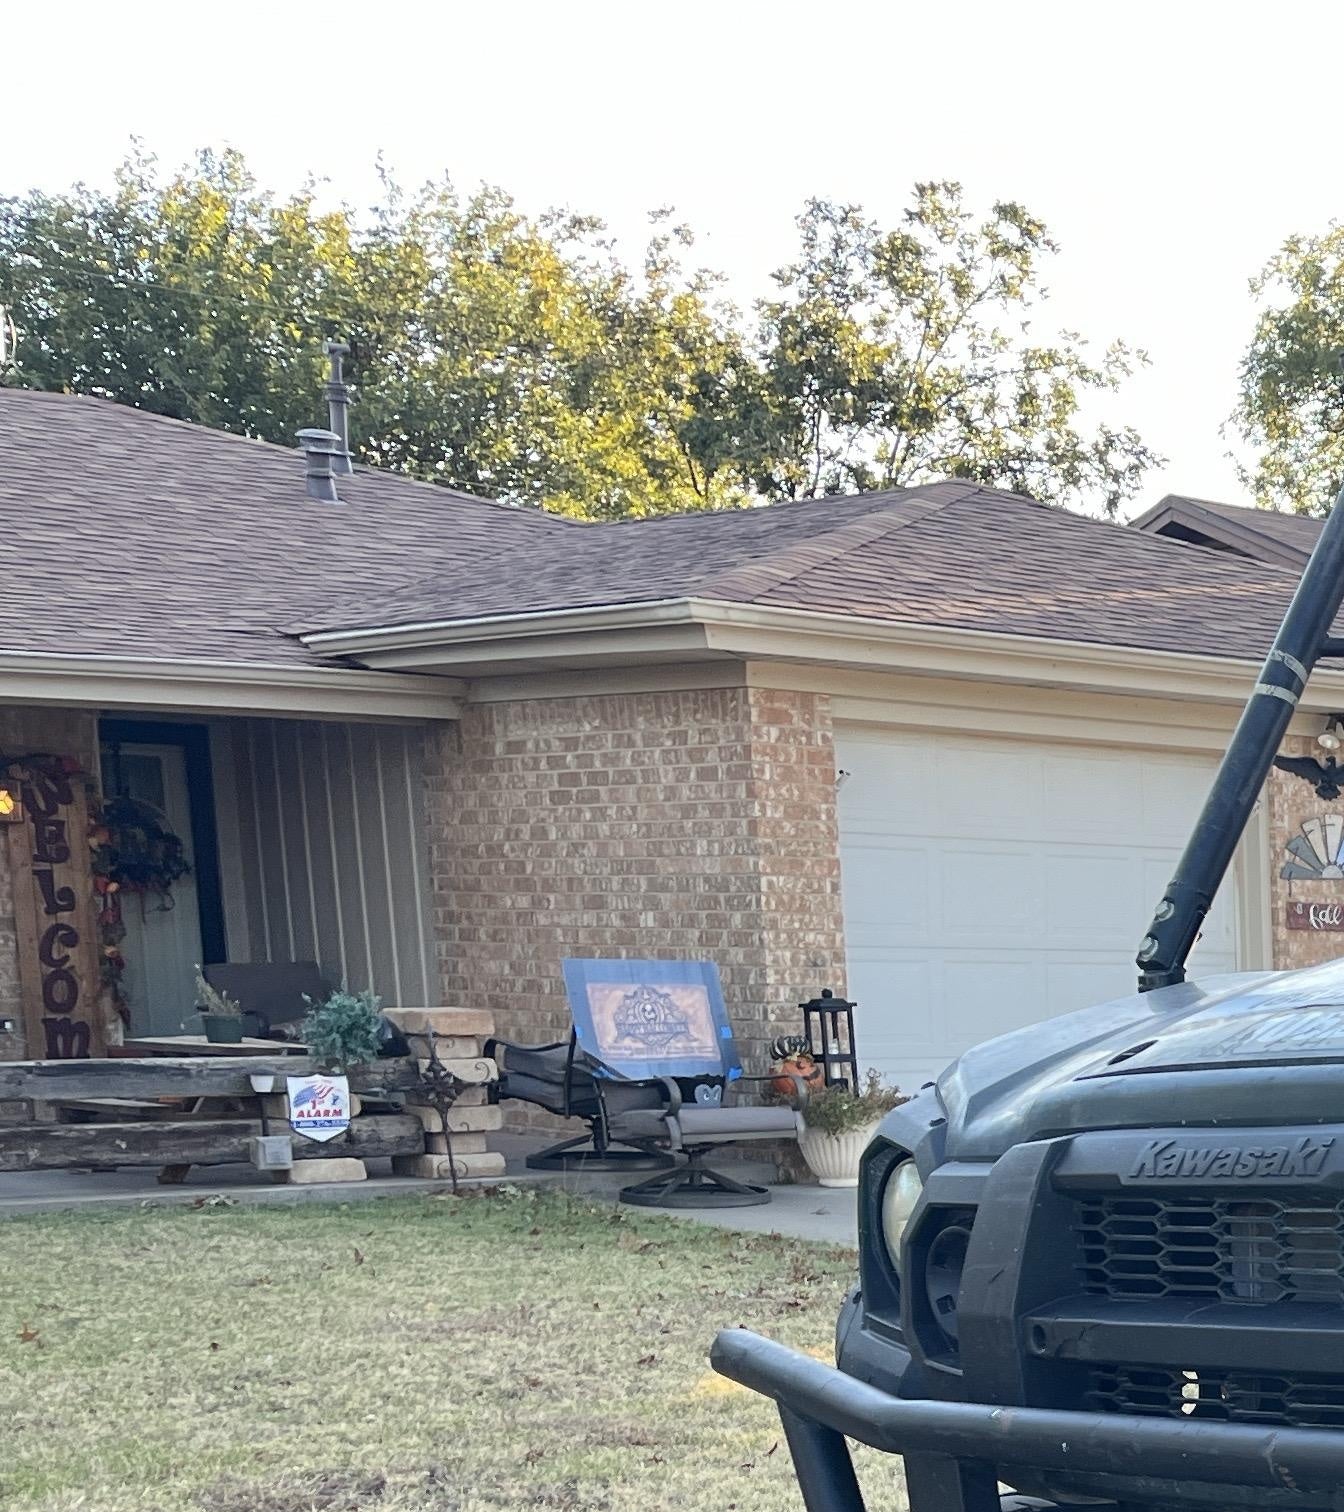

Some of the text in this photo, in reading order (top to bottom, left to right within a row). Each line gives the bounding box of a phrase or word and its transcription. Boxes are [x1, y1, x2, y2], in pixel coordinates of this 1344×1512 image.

[22, 766, 90, 1059] WELCOM
[296, 1108, 343, 1119] ALARM
[1129, 1136, 1337, 1179] Kawasaki
